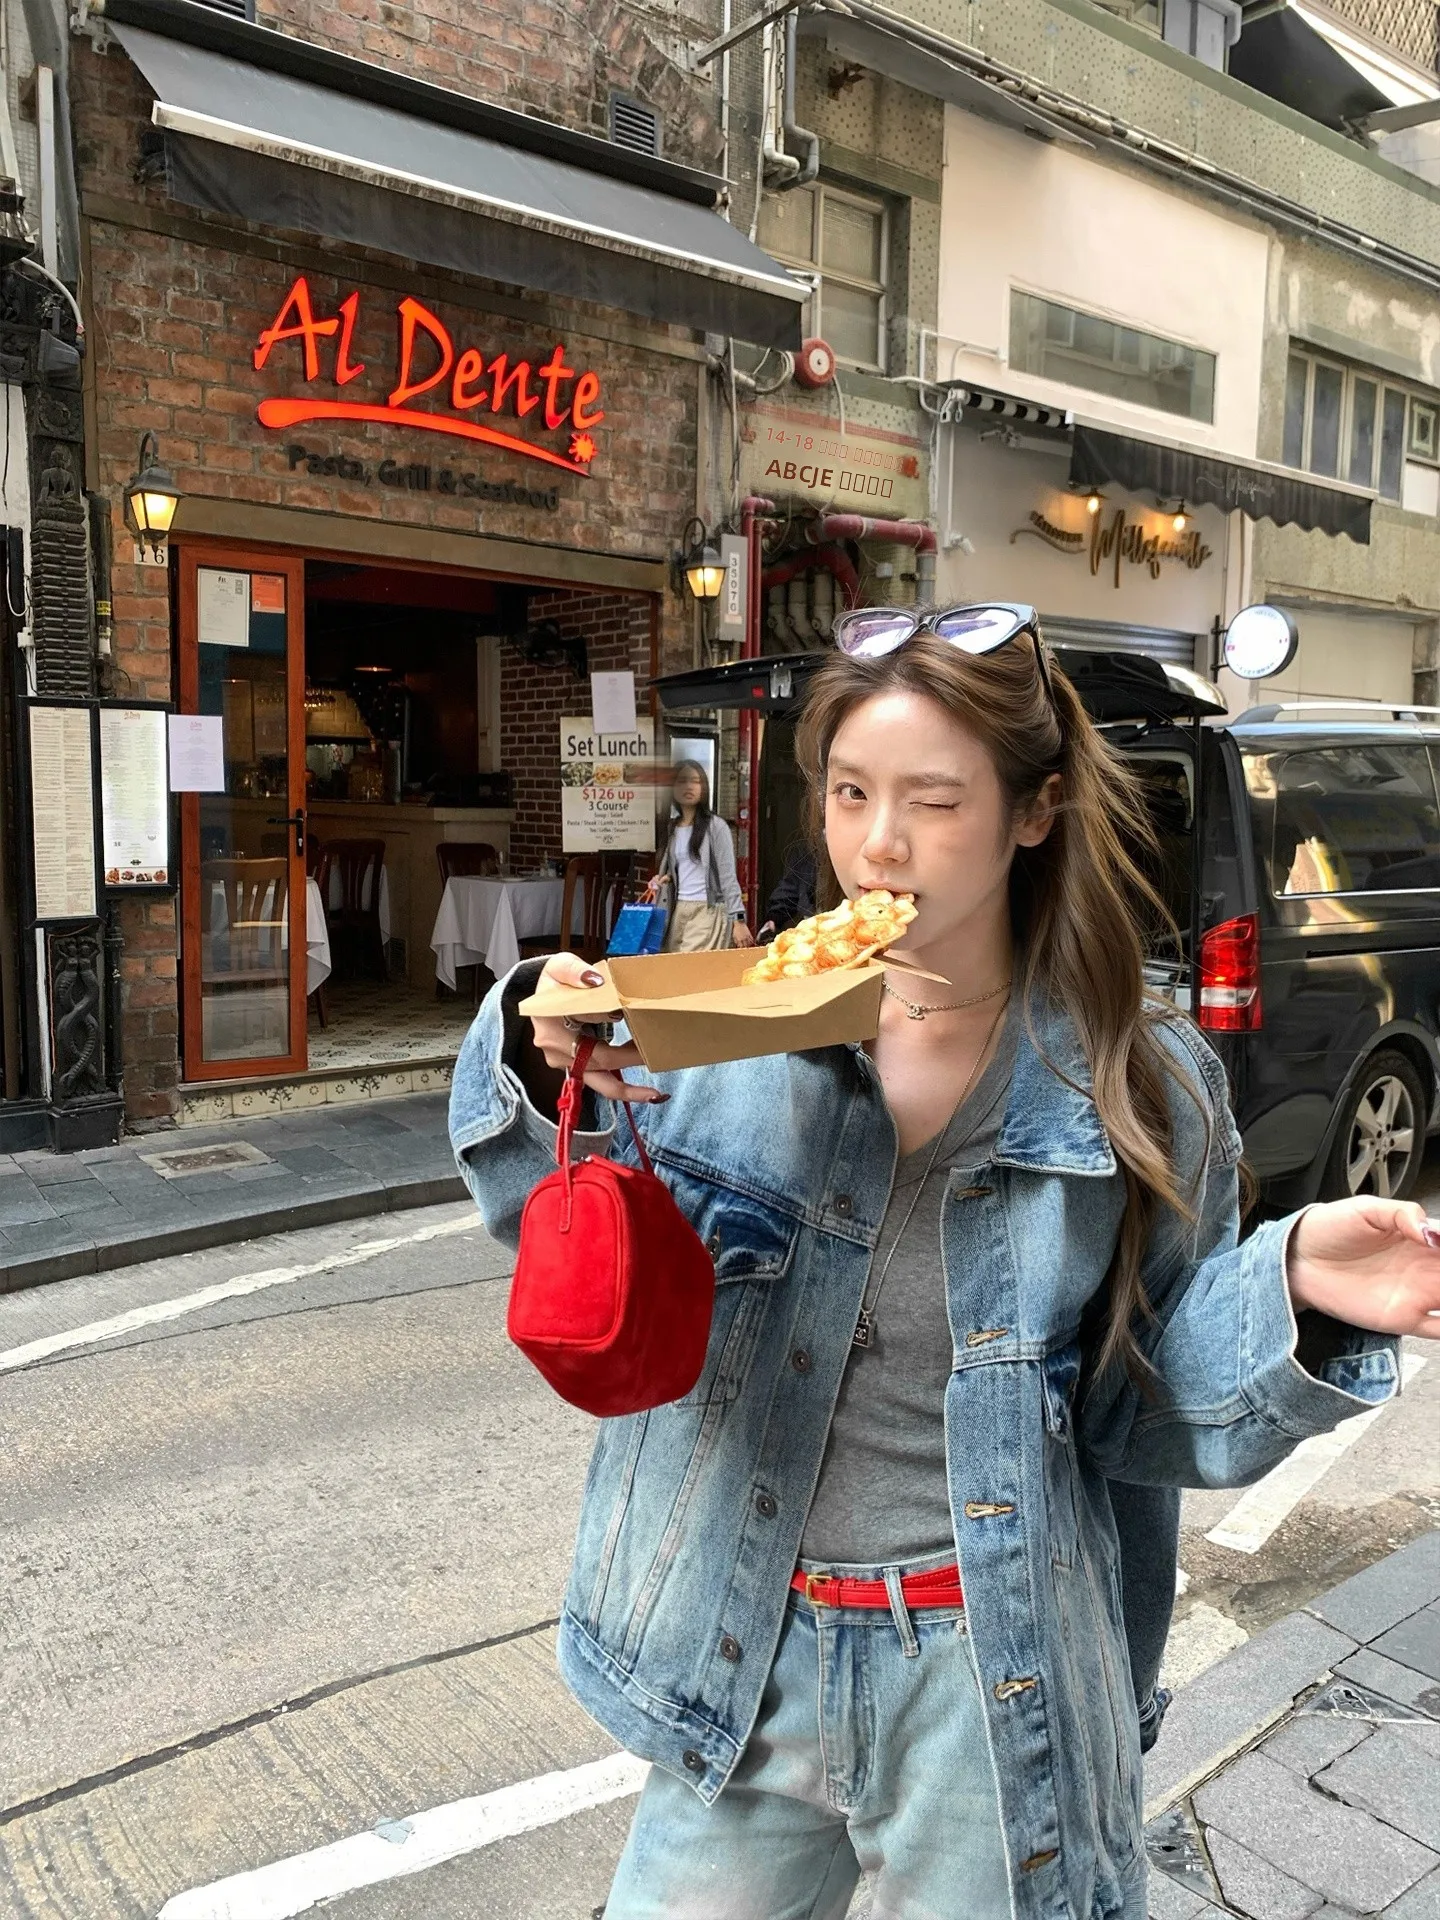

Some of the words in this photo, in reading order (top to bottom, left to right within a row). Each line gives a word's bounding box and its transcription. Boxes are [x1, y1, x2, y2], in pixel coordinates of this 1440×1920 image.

[253, 276, 364, 386] Al
[388, 297, 605, 431] Dente
[767, 427, 814, 451] 14-18
[378, 459, 432, 491] Grill
[437, 468, 457, 495] &
[460, 472, 559, 512] Seafood
[765, 459, 834, 489] ABCJE
[730, 557, 738, 612] 35070
[567, 735, 594, 757] Set
[600, 734, 648, 757] Lunch
[582, 788, 615, 801] $126
[618, 790, 635, 803] up
[588, 801, 594, 811] 3
[596, 801, 629, 811] Course
